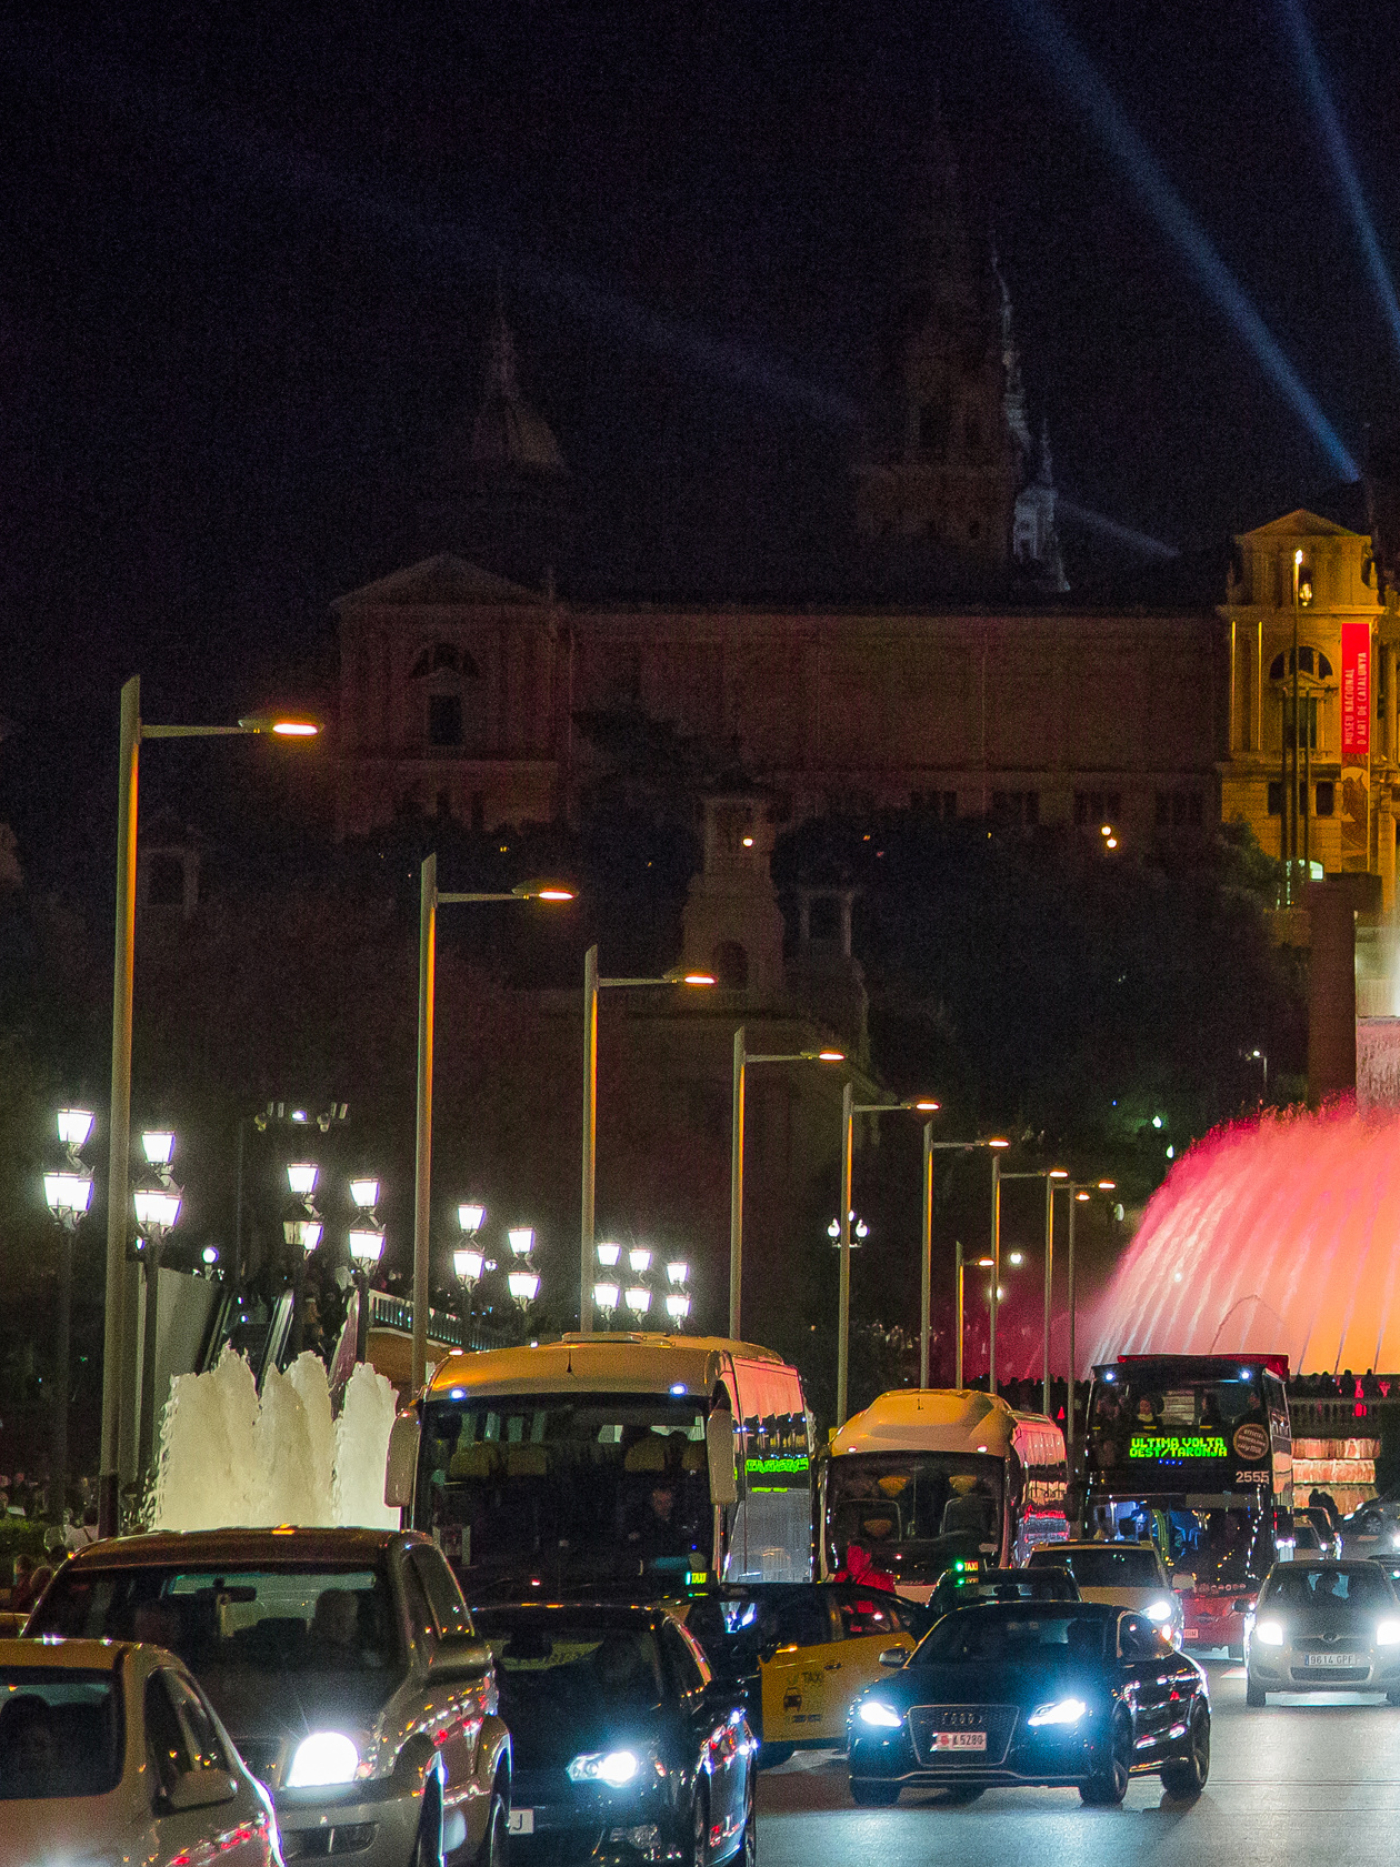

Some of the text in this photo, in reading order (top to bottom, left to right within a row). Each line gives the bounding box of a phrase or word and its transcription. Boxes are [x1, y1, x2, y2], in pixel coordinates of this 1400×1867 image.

[1357, 652, 1367, 702] CATALUNYA
[1344, 668, 1354, 745] MUSEU NACIONAL
[1357, 705, 1367, 716] DE
[1131, 1437, 1180, 1448] ULTIMA
[1181, 1437, 1225, 1448] VOLTA
[1129, 1446, 1228, 1458] OEST/TARONJA
[1235, 1470, 1270, 1484] 2555
[691, 1572, 707, 1584] TAXI
